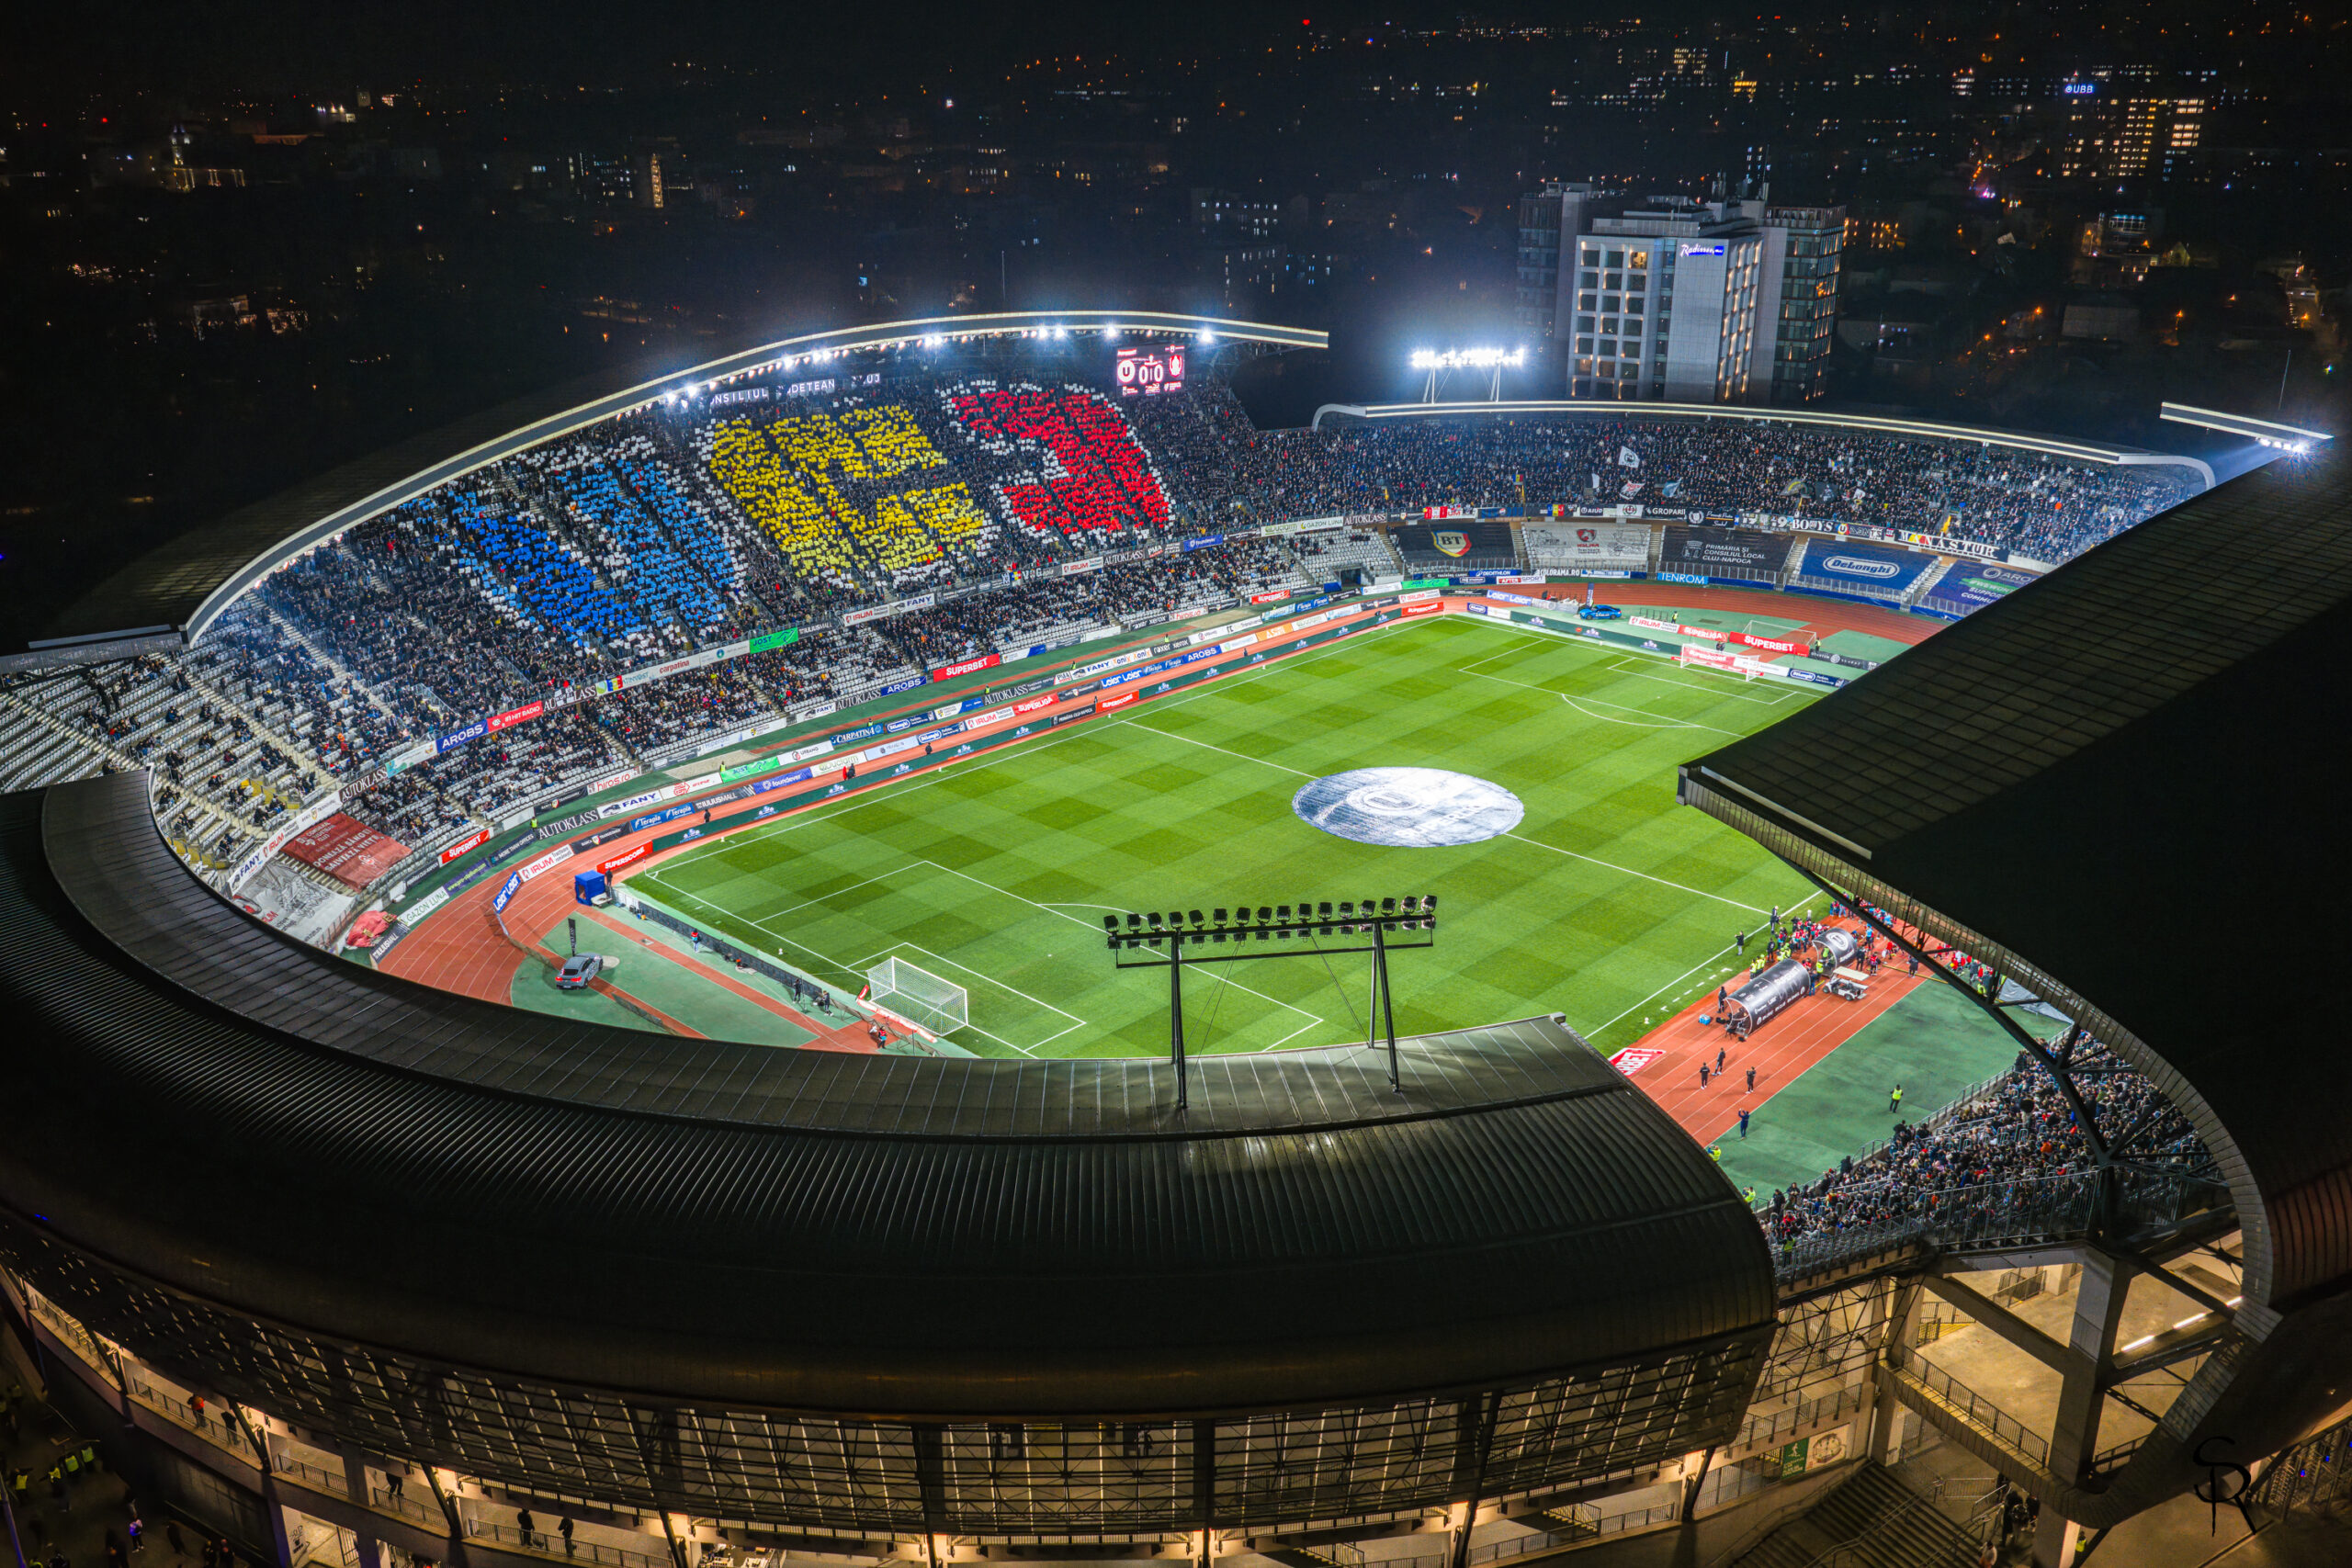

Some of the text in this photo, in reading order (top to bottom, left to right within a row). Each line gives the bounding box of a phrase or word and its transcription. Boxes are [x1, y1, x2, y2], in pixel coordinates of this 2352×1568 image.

[2073, 85, 2094, 94] UBB
[1344, 513, 1386, 525] AUTOKLASS
[1440, 536, 1463, 546] BT
[1069, 561, 1090, 571] IRUM
[1103, 550, 1144, 566] AUTOKLASS
[1660, 572, 1705, 585] TENROM
[906, 596, 932, 607] FANY
[853, 610, 874, 622] IRUM
[1638, 619, 1661, 628] IRUM
[752, 635, 773, 647] JOST
[1744, 635, 1794, 652] SUPERBET
[1187, 648, 1217, 662] AROBS
[660, 660, 690, 674] carpatina
[946, 657, 989, 677] SUPERBET
[1087, 661, 1110, 672] FANY
[887, 678, 922, 694] AROBS
[836, 689, 882, 711] AUTOKLASS
[984, 684, 1029, 705] AUTOKLASS
[816, 705, 833, 713] FANY
[1018, 696, 1053, 712] SUPERLIGA
[976, 714, 998, 726] IRUM
[441, 724, 484, 750] AROBS
[836, 727, 875, 744] CARPATINA
[341, 766, 388, 804] AUTOKLASS
[772, 774, 802, 787] foundever
[622, 793, 657, 807] FANY
[539, 809, 599, 840] AUTOKLASS
[268, 832, 285, 854] IRUM
[449, 834, 481, 858] SUPERBET
[239, 852, 260, 878] FANY
[531, 856, 555, 874] IRUM
[605, 846, 645, 870] SUPERSCORE
[406, 888, 447, 922] GAZON LUNA
